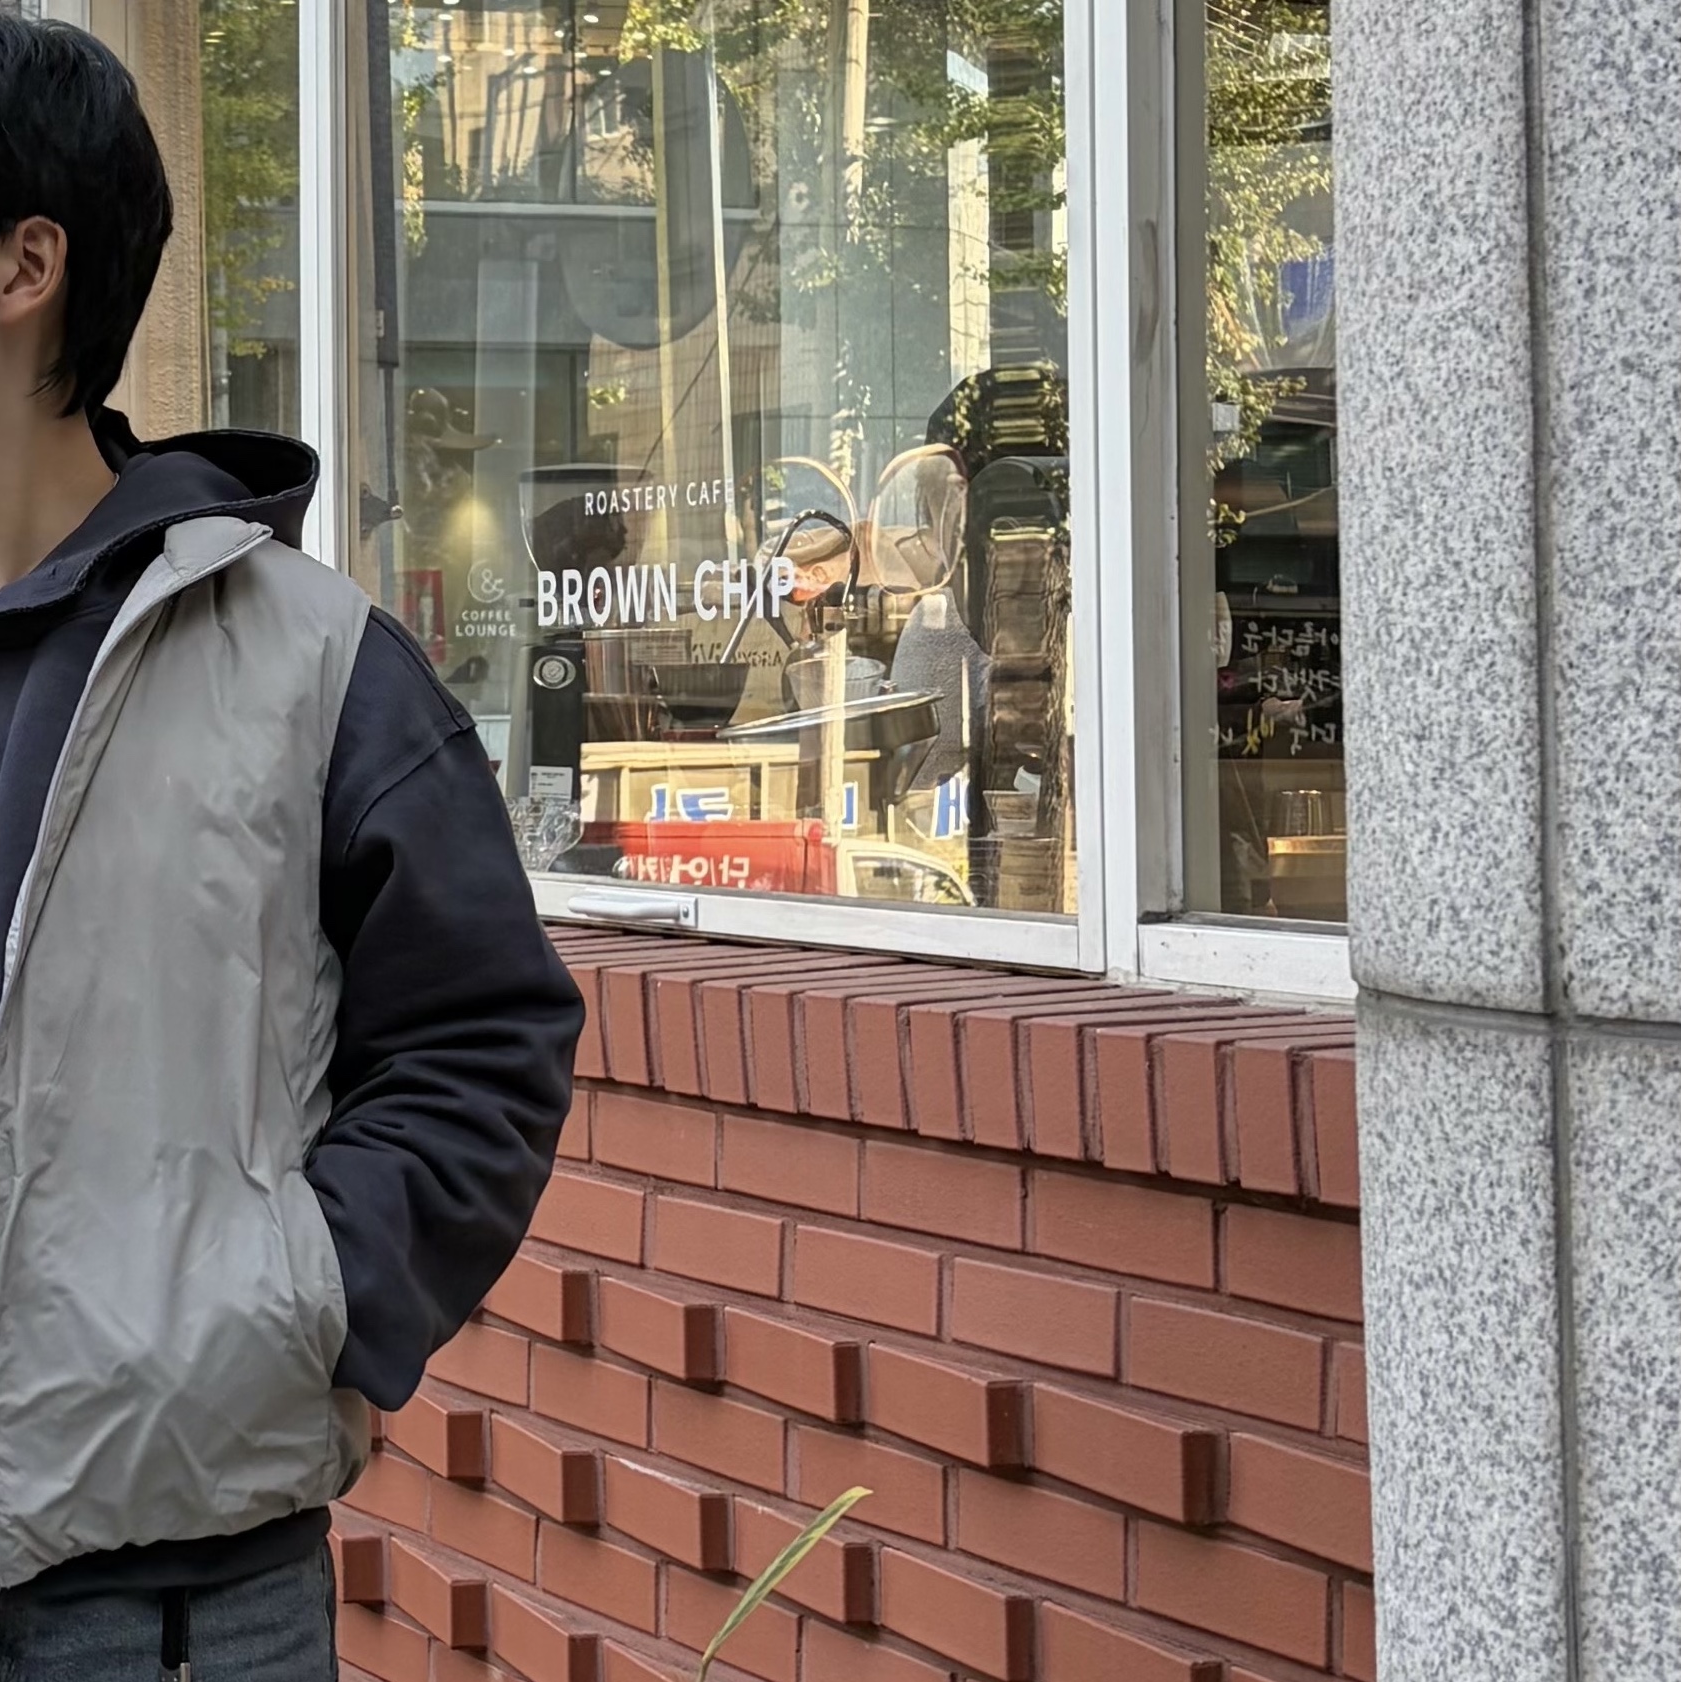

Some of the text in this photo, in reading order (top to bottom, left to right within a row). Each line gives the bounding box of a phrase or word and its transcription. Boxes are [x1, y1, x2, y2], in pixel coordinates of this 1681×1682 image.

[584, 479, 734, 516] ROASTERY CAFE
[537, 556, 795, 627] BROWN CHIP
[461, 608, 512, 622] COFFEE
[454, 623, 517, 638] LOUNGE
